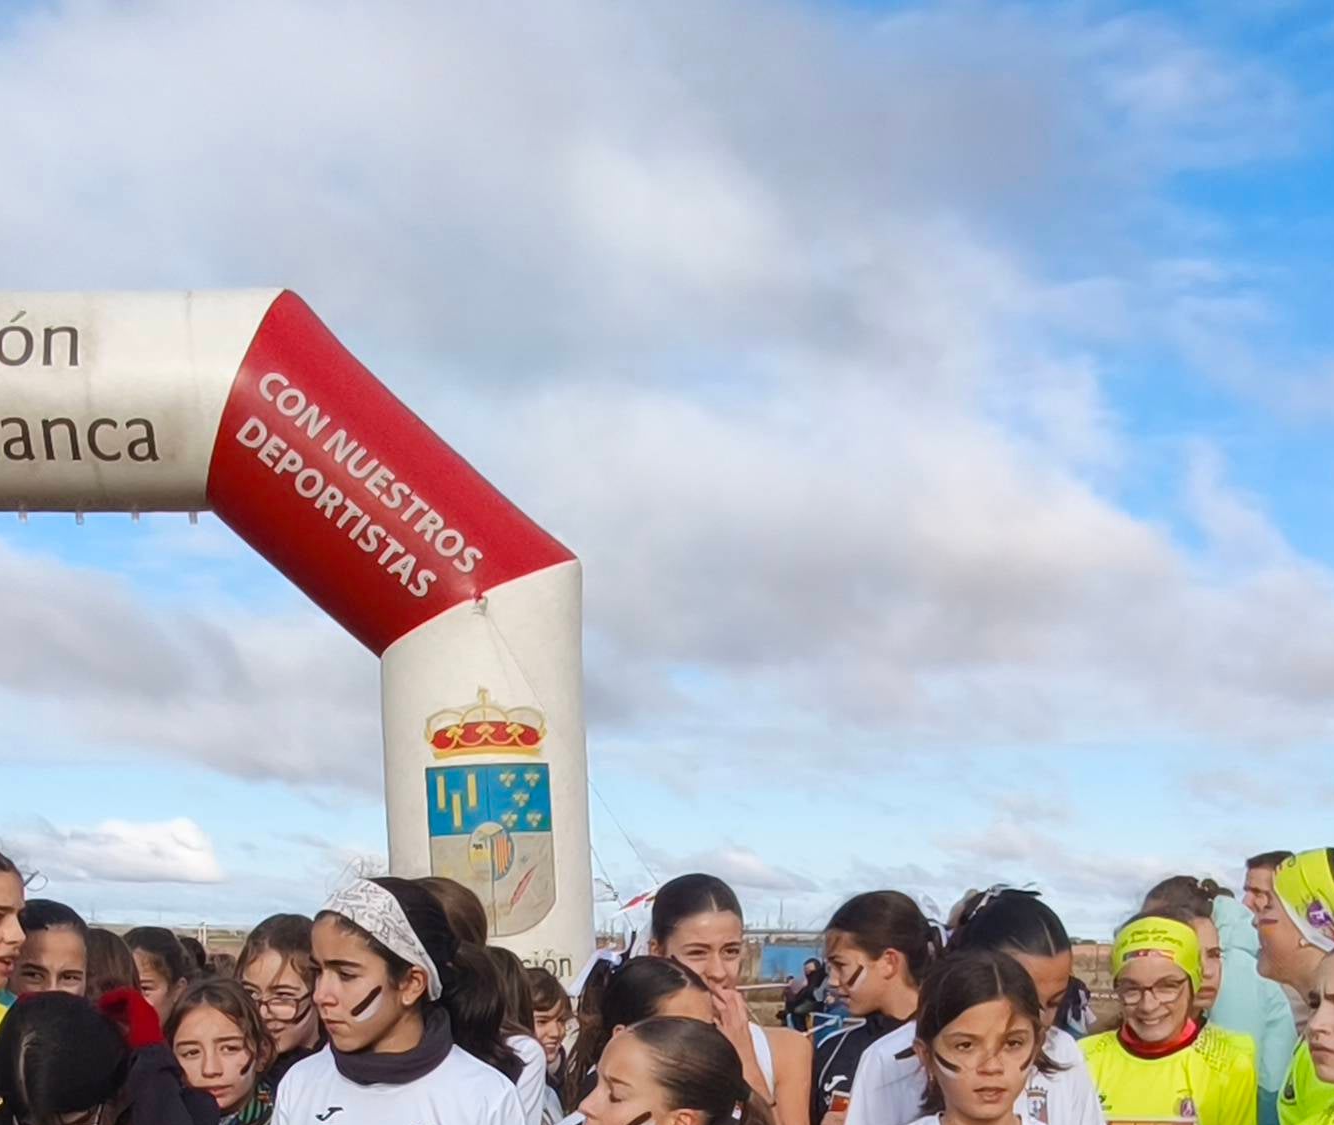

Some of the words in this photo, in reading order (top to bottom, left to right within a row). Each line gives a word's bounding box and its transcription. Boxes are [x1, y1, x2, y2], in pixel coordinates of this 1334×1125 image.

[236, 416, 437, 597] DEPORTISTAS
[259, 372, 331, 439] CON
[322, 429, 483, 573] NUESTROS
